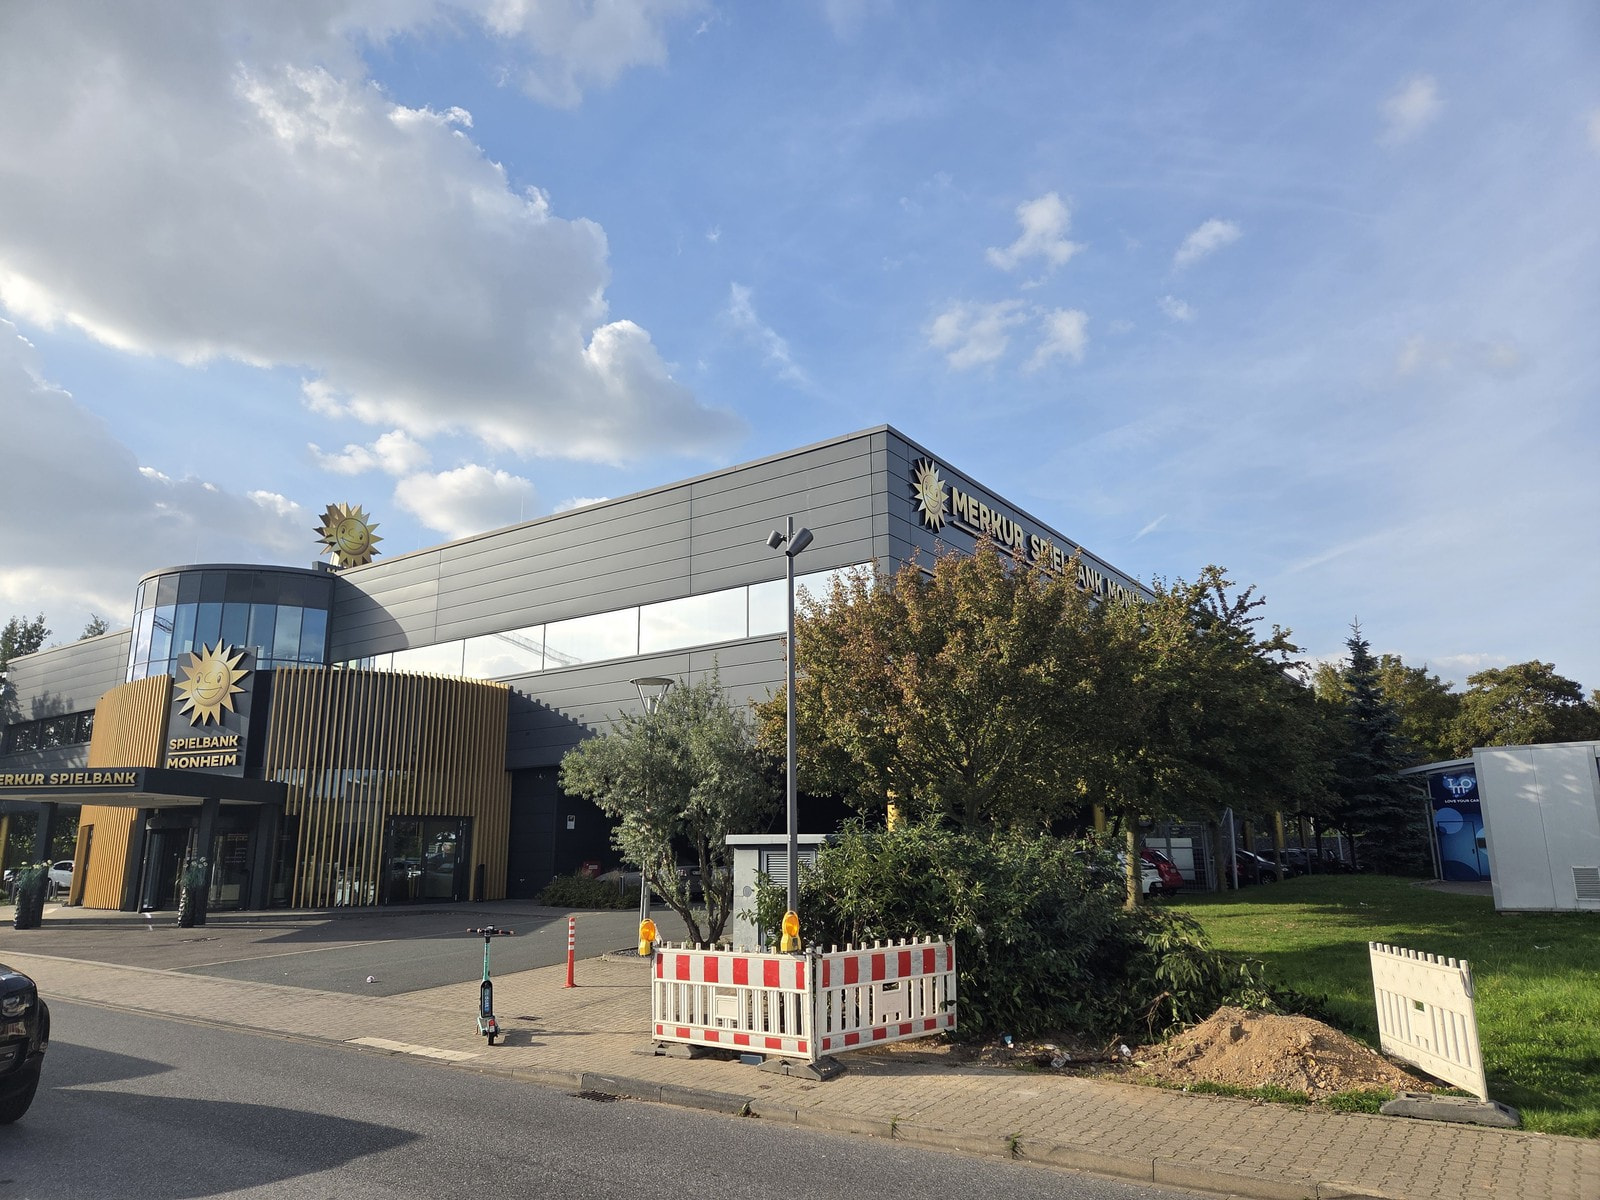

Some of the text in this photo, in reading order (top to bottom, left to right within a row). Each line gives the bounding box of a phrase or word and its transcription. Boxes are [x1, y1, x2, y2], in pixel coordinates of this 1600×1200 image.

[952, 486, 1024, 549] MERKUR
[1030, 533, 1104, 596] SPIELANK
[169, 735, 238, 750] SPIELBANK
[166, 754, 237, 769] MONHEIM
[0, 772, 136, 785] ERKUR SPIELBANK
